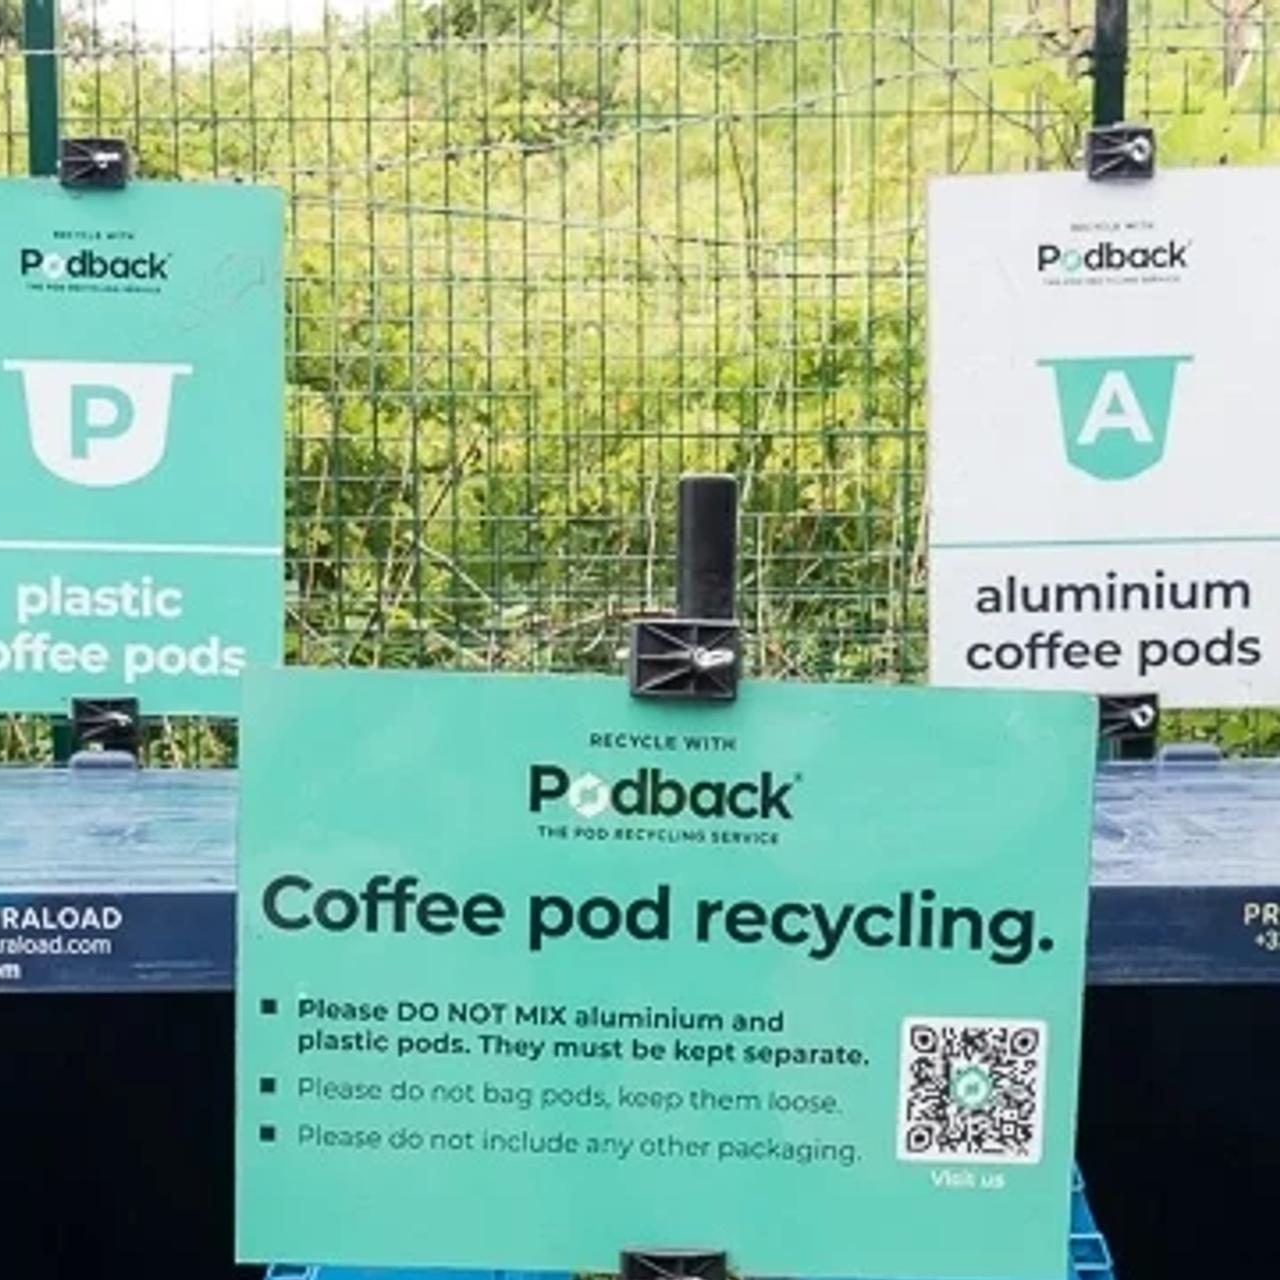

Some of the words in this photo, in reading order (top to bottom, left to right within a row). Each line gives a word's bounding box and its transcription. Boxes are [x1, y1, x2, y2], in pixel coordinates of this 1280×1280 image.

[70, 383, 135, 460] P
[1077, 370, 1154, 445] A
[16, 575, 183, 625] plastic
[976, 569, 1251, 614] aluminium
[124, 635, 248, 684] pods
[966, 630, 1122, 671] coffee
[1138, 627, 1262, 677] pods
[589, 732, 677, 751] RECYCLE
[683, 735, 736, 751] WITH
[537, 824, 568, 839] THE
[573, 826, 610, 841] POD
[614, 827, 706, 844] RECYCLING
[710, 831, 779, 845] SERVICE
[262, 875, 506, 929] Coffee
[529, 884, 671, 952] pod
[696, 888, 1054, 965] recycling.
[298, 998, 389, 1022] Please
[397, 1001, 439, 1022] DO
[447, 1002, 507, 1025] NOT
[515, 1005, 567, 1026] MIX
[574, 1005, 724, 1031] aluminium
[731, 1010, 784, 1033] and
[298, 1029, 389, 1055] plastic
[397, 1032, 471, 1058] pods.
[477, 1034, 546, 1062] They
[553, 1039, 623, 1059] must
[631, 1038, 667, 1061] be
[674, 1038, 735, 1067] kept
[743, 1045, 870, 1068] separate.
[298, 1076, 382, 1100] Please
[390, 1080, 425, 1102] do
[431, 1083, 476, 1104] not
[483, 1081, 533, 1111] bag
[540, 1084, 612, 1110] pods,
[618, 1085, 684, 1113] keep
[689, 1088, 762, 1111] them
[767, 1091, 842, 1115] loose.
[298, 1123, 382, 1149] Please
[387, 1127, 425, 1150] do
[430, 1132, 474, 1150] not
[482, 1130, 580, 1154] include
[586, 1137, 635, 1161] any
[639, 1134, 711, 1158] other
[717, 1137, 862, 1168] packaging.
[931, 1169, 976, 1188] Visit
[981, 1173, 1006, 1189] us
